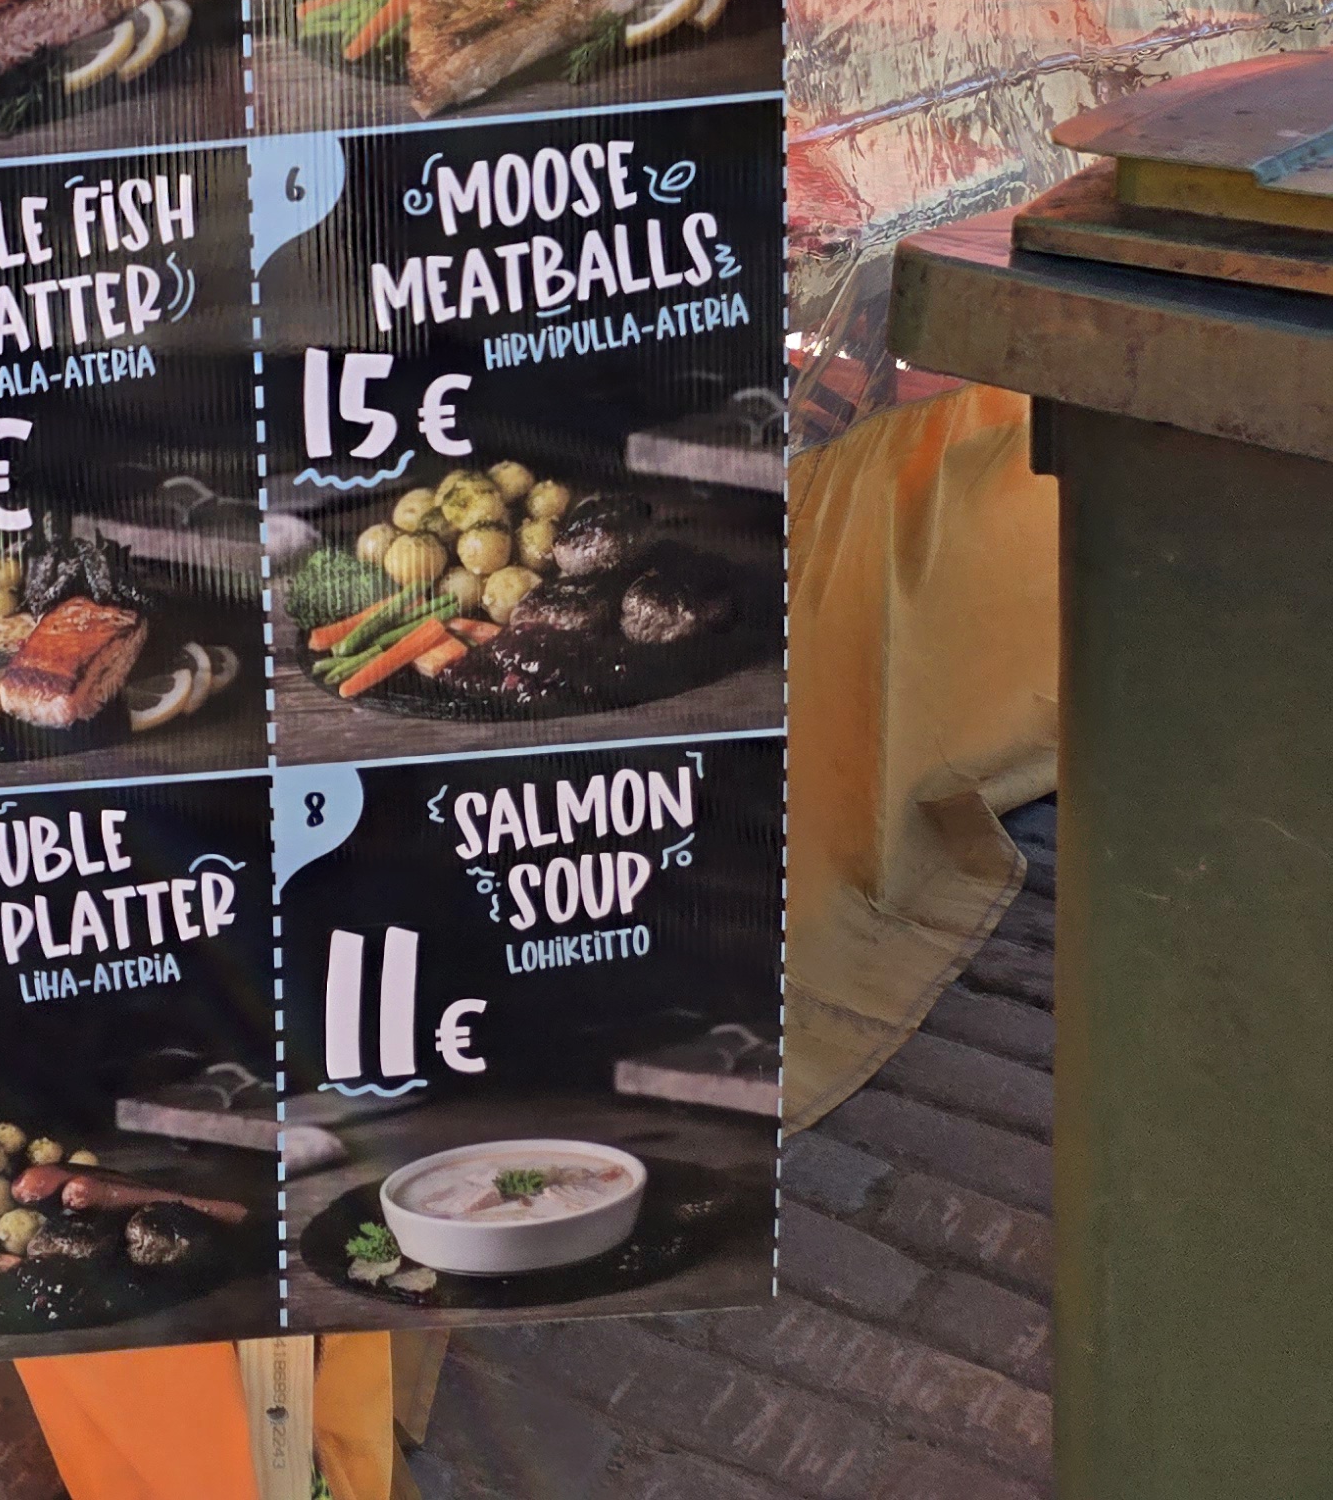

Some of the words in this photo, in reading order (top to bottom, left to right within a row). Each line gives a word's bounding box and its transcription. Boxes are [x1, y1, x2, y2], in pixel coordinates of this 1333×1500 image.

[285, 166, 304, 202] 6
[437, 140, 638, 236] MOOSE
[371, 212, 722, 333] MEATBALLS
[304, 791, 325, 828] 8
[453, 766, 694, 860] SALMON
[1, 872, 236, 966] PLATTER
[507, 851, 650, 931] SOUP
